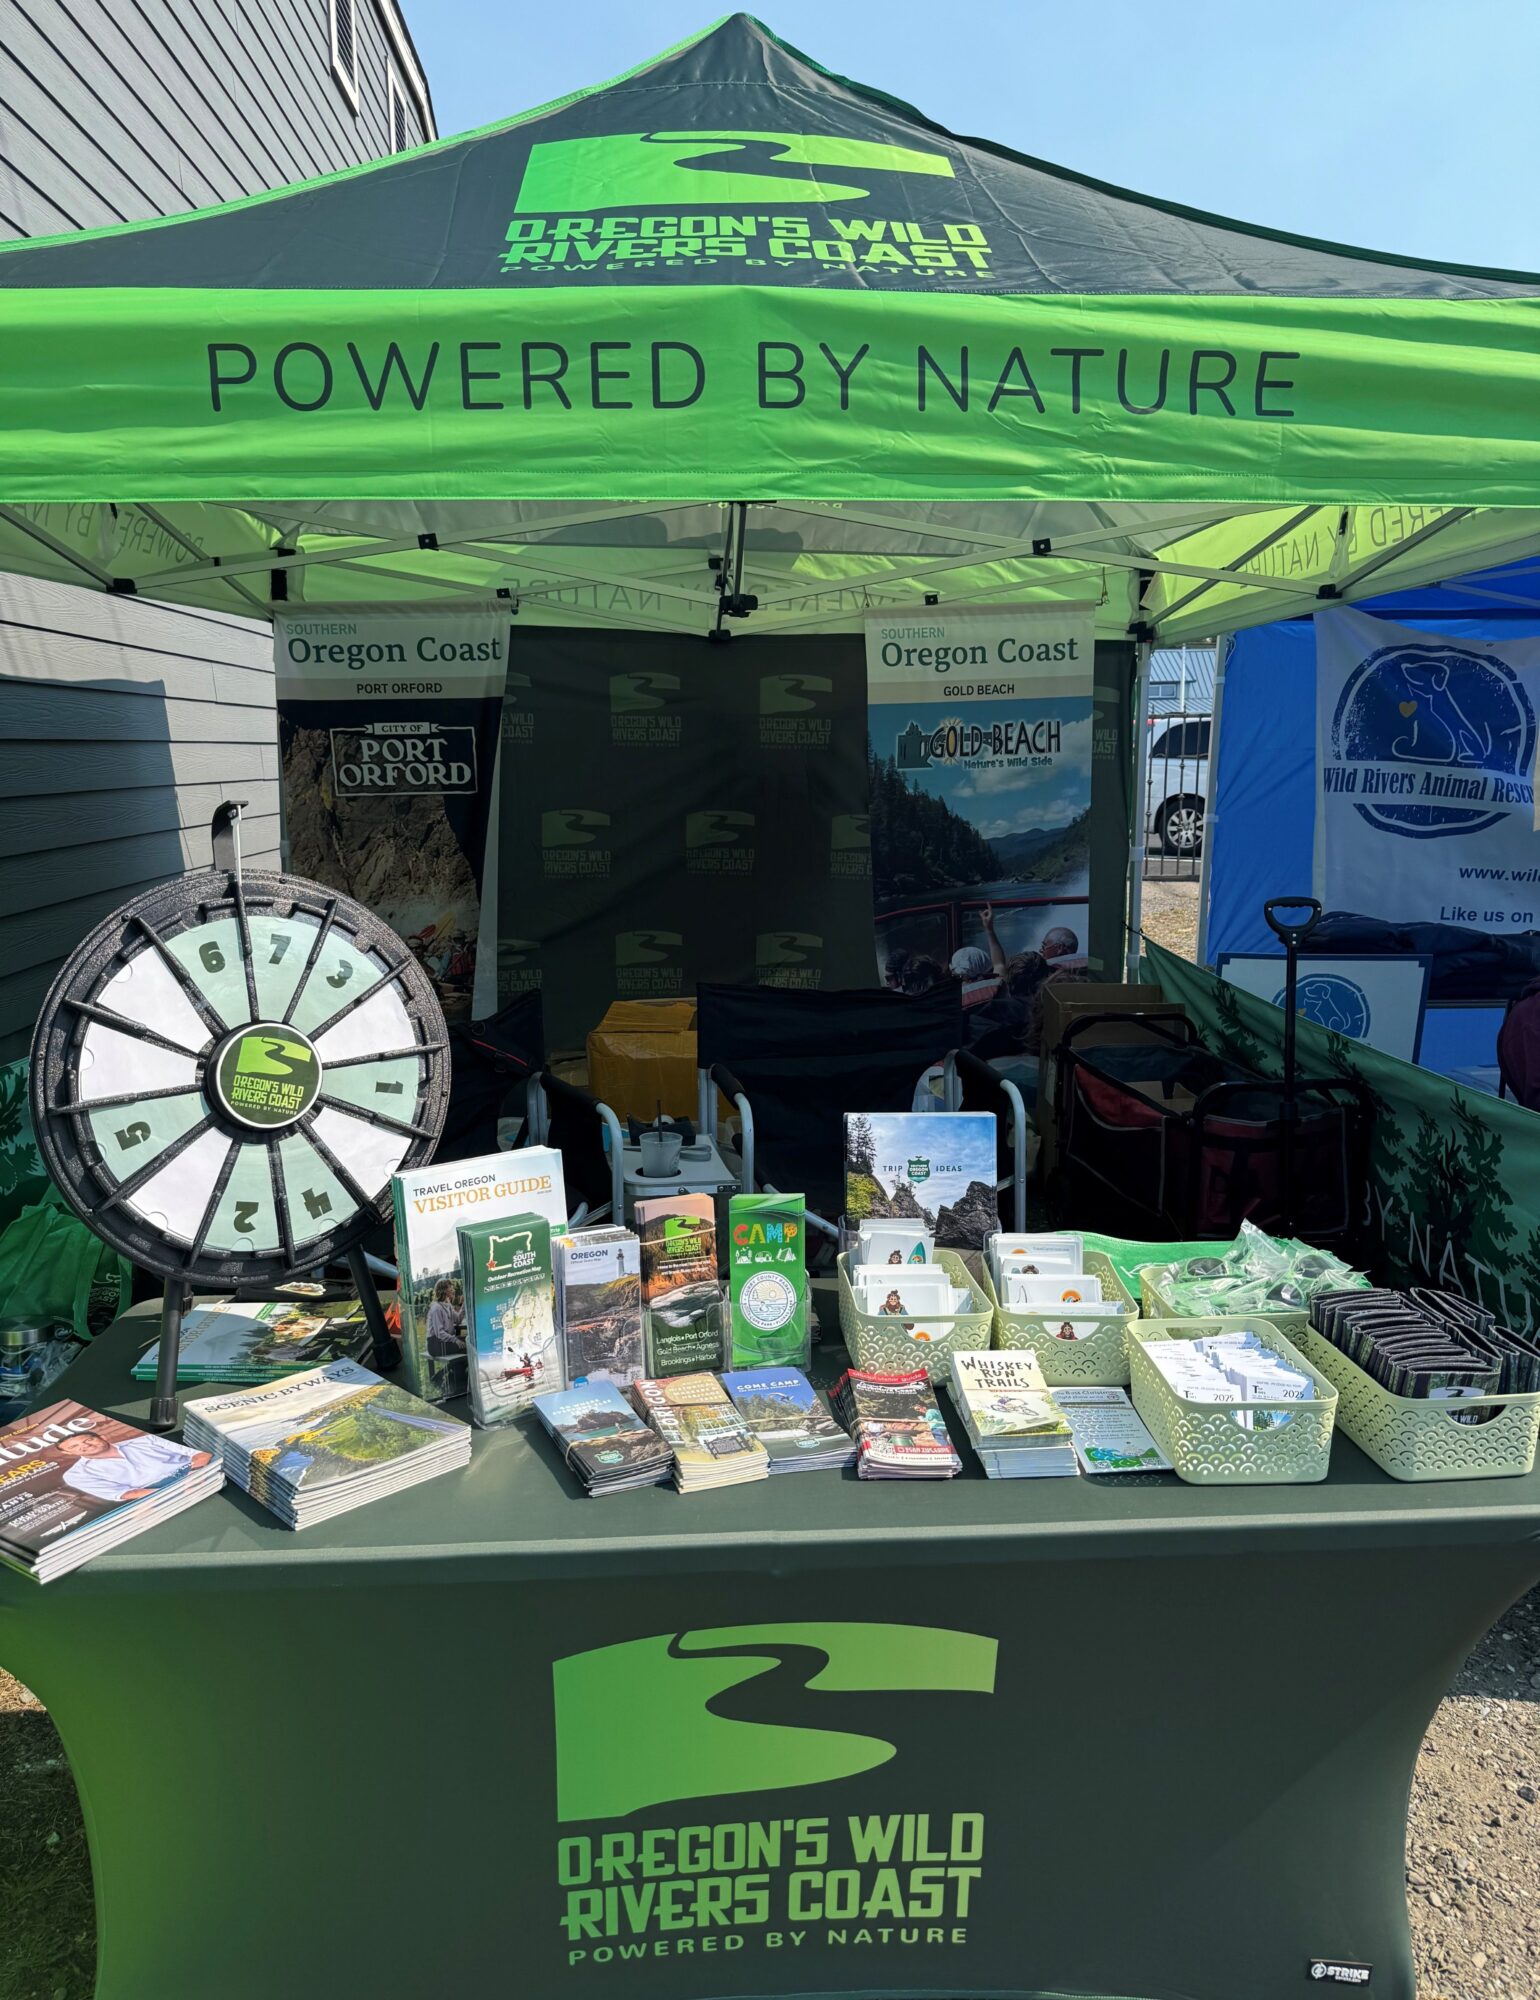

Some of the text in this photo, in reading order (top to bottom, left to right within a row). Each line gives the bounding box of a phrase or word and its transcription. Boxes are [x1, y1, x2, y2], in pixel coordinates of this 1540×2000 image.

[505, 216, 987, 247] OREGON'S WILD
[499, 237, 993, 269] RIVERS COAST
[500, 258, 996, 280] POWERED BY NATURE
[207, 341, 1300, 418] POWERED BY NATURE
[286, 622, 357, 636] SOUTHERN
[881, 627, 945, 639] SOUTHERN
[287, 636, 502, 671] Oregon Coast
[881, 637, 1079, 673] Oregon Coast
[356, 681, 443, 695] PORT ORFORD
[943, 684, 1015, 696] GOLD BEACH
[381, 725, 423, 733] CITY OF
[929, 720, 1061, 758] GOLD BEACH
[360, 739, 448, 762] PORT
[1007, 757, 1028, 767] Wild
[1031, 756, 1053, 766] Side
[339, 762, 472, 786] ORFORD
[1323, 767, 1356, 793] Wild
[1362, 768, 1415, 794] Rivers
[1419, 771, 1488, 801] Animal
[1440, 906, 1534, 924] Like us on
[198, 941, 227, 974] 6
[269, 933, 292, 965] 7
[325, 959, 354, 989] 3
[233, 1075, 304, 1097] OREGON'S WILD
[375, 1079, 404, 1095] 1
[231, 1087, 302, 1110] RIVERS COAST
[231, 1101, 261, 1110] POWERED
[113, 1121, 152, 1151] 5
[413, 1174, 496, 1197] TRAVEL OREGON
[414, 1175, 552, 1214] VISITOR GUIDE
[301, 1187, 333, 1221] 4
[234, 1201, 260, 1234] 2
[733, 1222, 798, 1246] CAMP
[513, 1251, 536, 1262] SOUTH
[513, 1258, 535, 1268] COAST
[571, 1249, 608, 1260] OREGON
[656, 1330, 719, 1345] Langlois Port Orford
[657, 1347, 672, 1355] Gold
[696, 1342, 719, 1351] Agness
[661, 1353, 717, 1366] Brookings Harbor
[961, 1356, 1032, 1371] WHISKEY
[975, 1378, 1029, 1389] TRAILS
[980, 1369, 1015, 1378] RUN
[204, 1366, 355, 1413] SCENIC BYWAYS
[736, 1382, 767, 1391] COME
[770, 1379, 799, 1387] CAMP
[1283, 1390, 1304, 1399] 2025
[1460, 1415, 1478, 1424] WILD
[0, 1417, 97, 1466] tude
[558, 1812, 985, 1886] OREGON'S WILD
[559, 1867, 982, 1941] RIVERS COAST
[568, 1928, 968, 1966] POWERED BY NATURE
[1327, 1966, 1369, 1980] STRIKE
